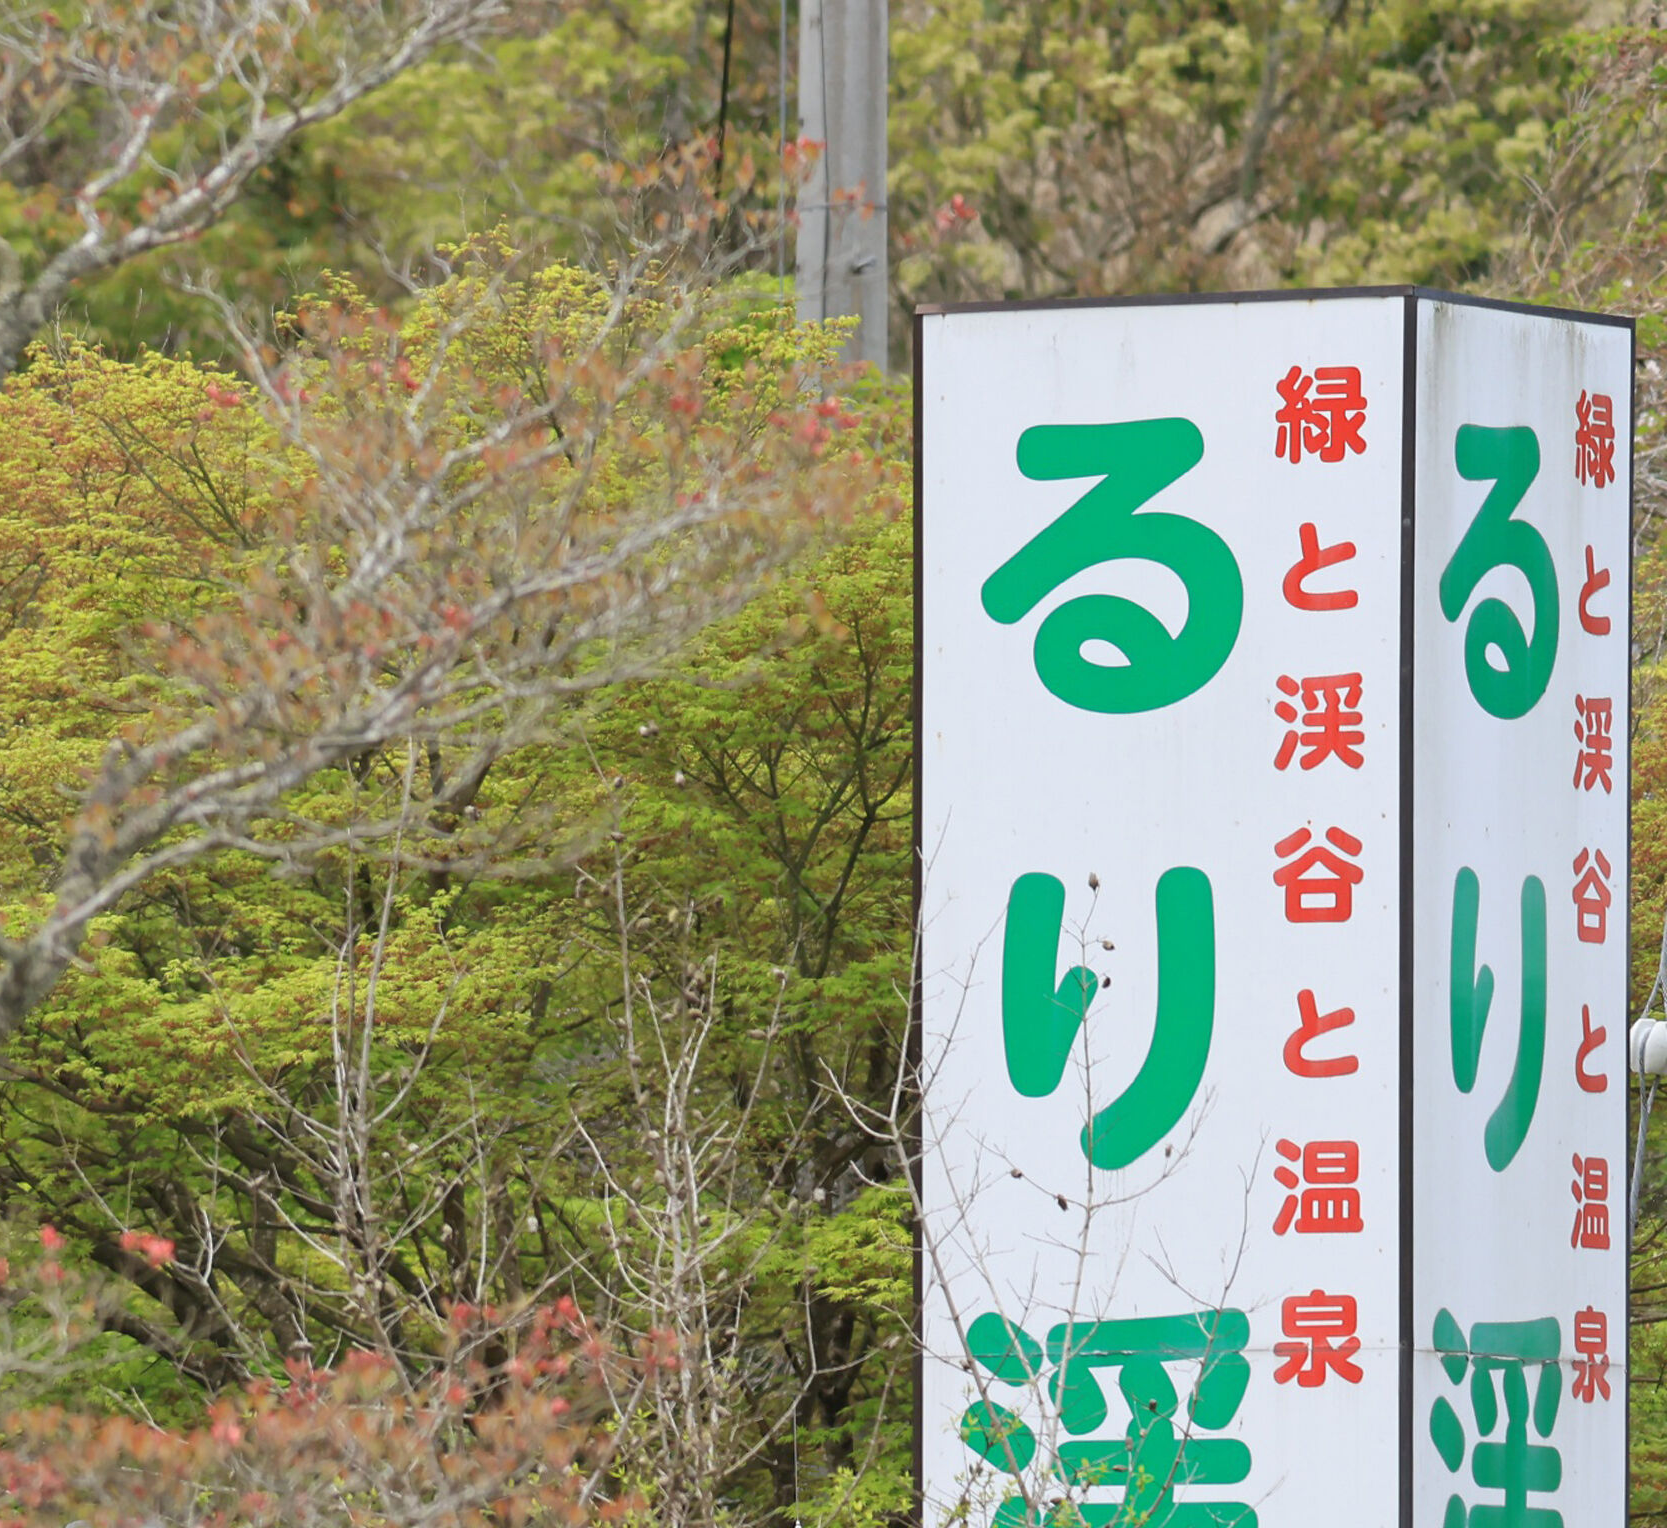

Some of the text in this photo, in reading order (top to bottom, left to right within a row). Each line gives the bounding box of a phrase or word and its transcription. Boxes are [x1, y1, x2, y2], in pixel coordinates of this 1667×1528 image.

[1273, 365, 1368, 1388] 緑と渓谷と温泉
[1569, 389, 1616, 1404] 緑と渓谷と温泉
